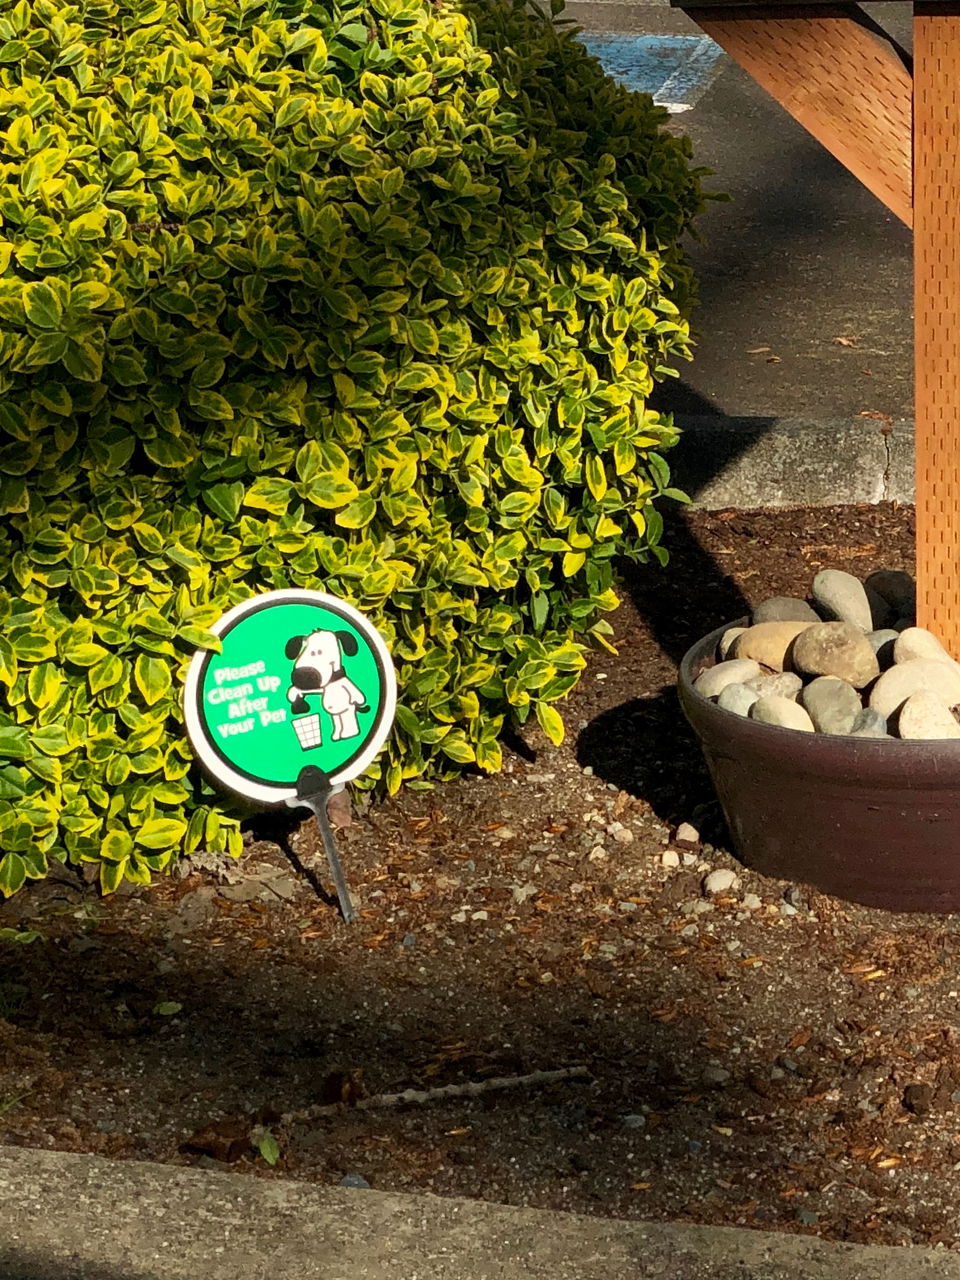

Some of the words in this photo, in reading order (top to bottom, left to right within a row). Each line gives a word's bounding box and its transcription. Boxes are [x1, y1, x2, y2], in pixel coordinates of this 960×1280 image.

[214, 660, 266, 685] Please
[207, 681, 253, 705] Clean
[256, 675, 281, 693] Up
[228, 696, 268, 719] After
[217, 717, 255, 739] Your
[260, 708, 287, 728] Pet
